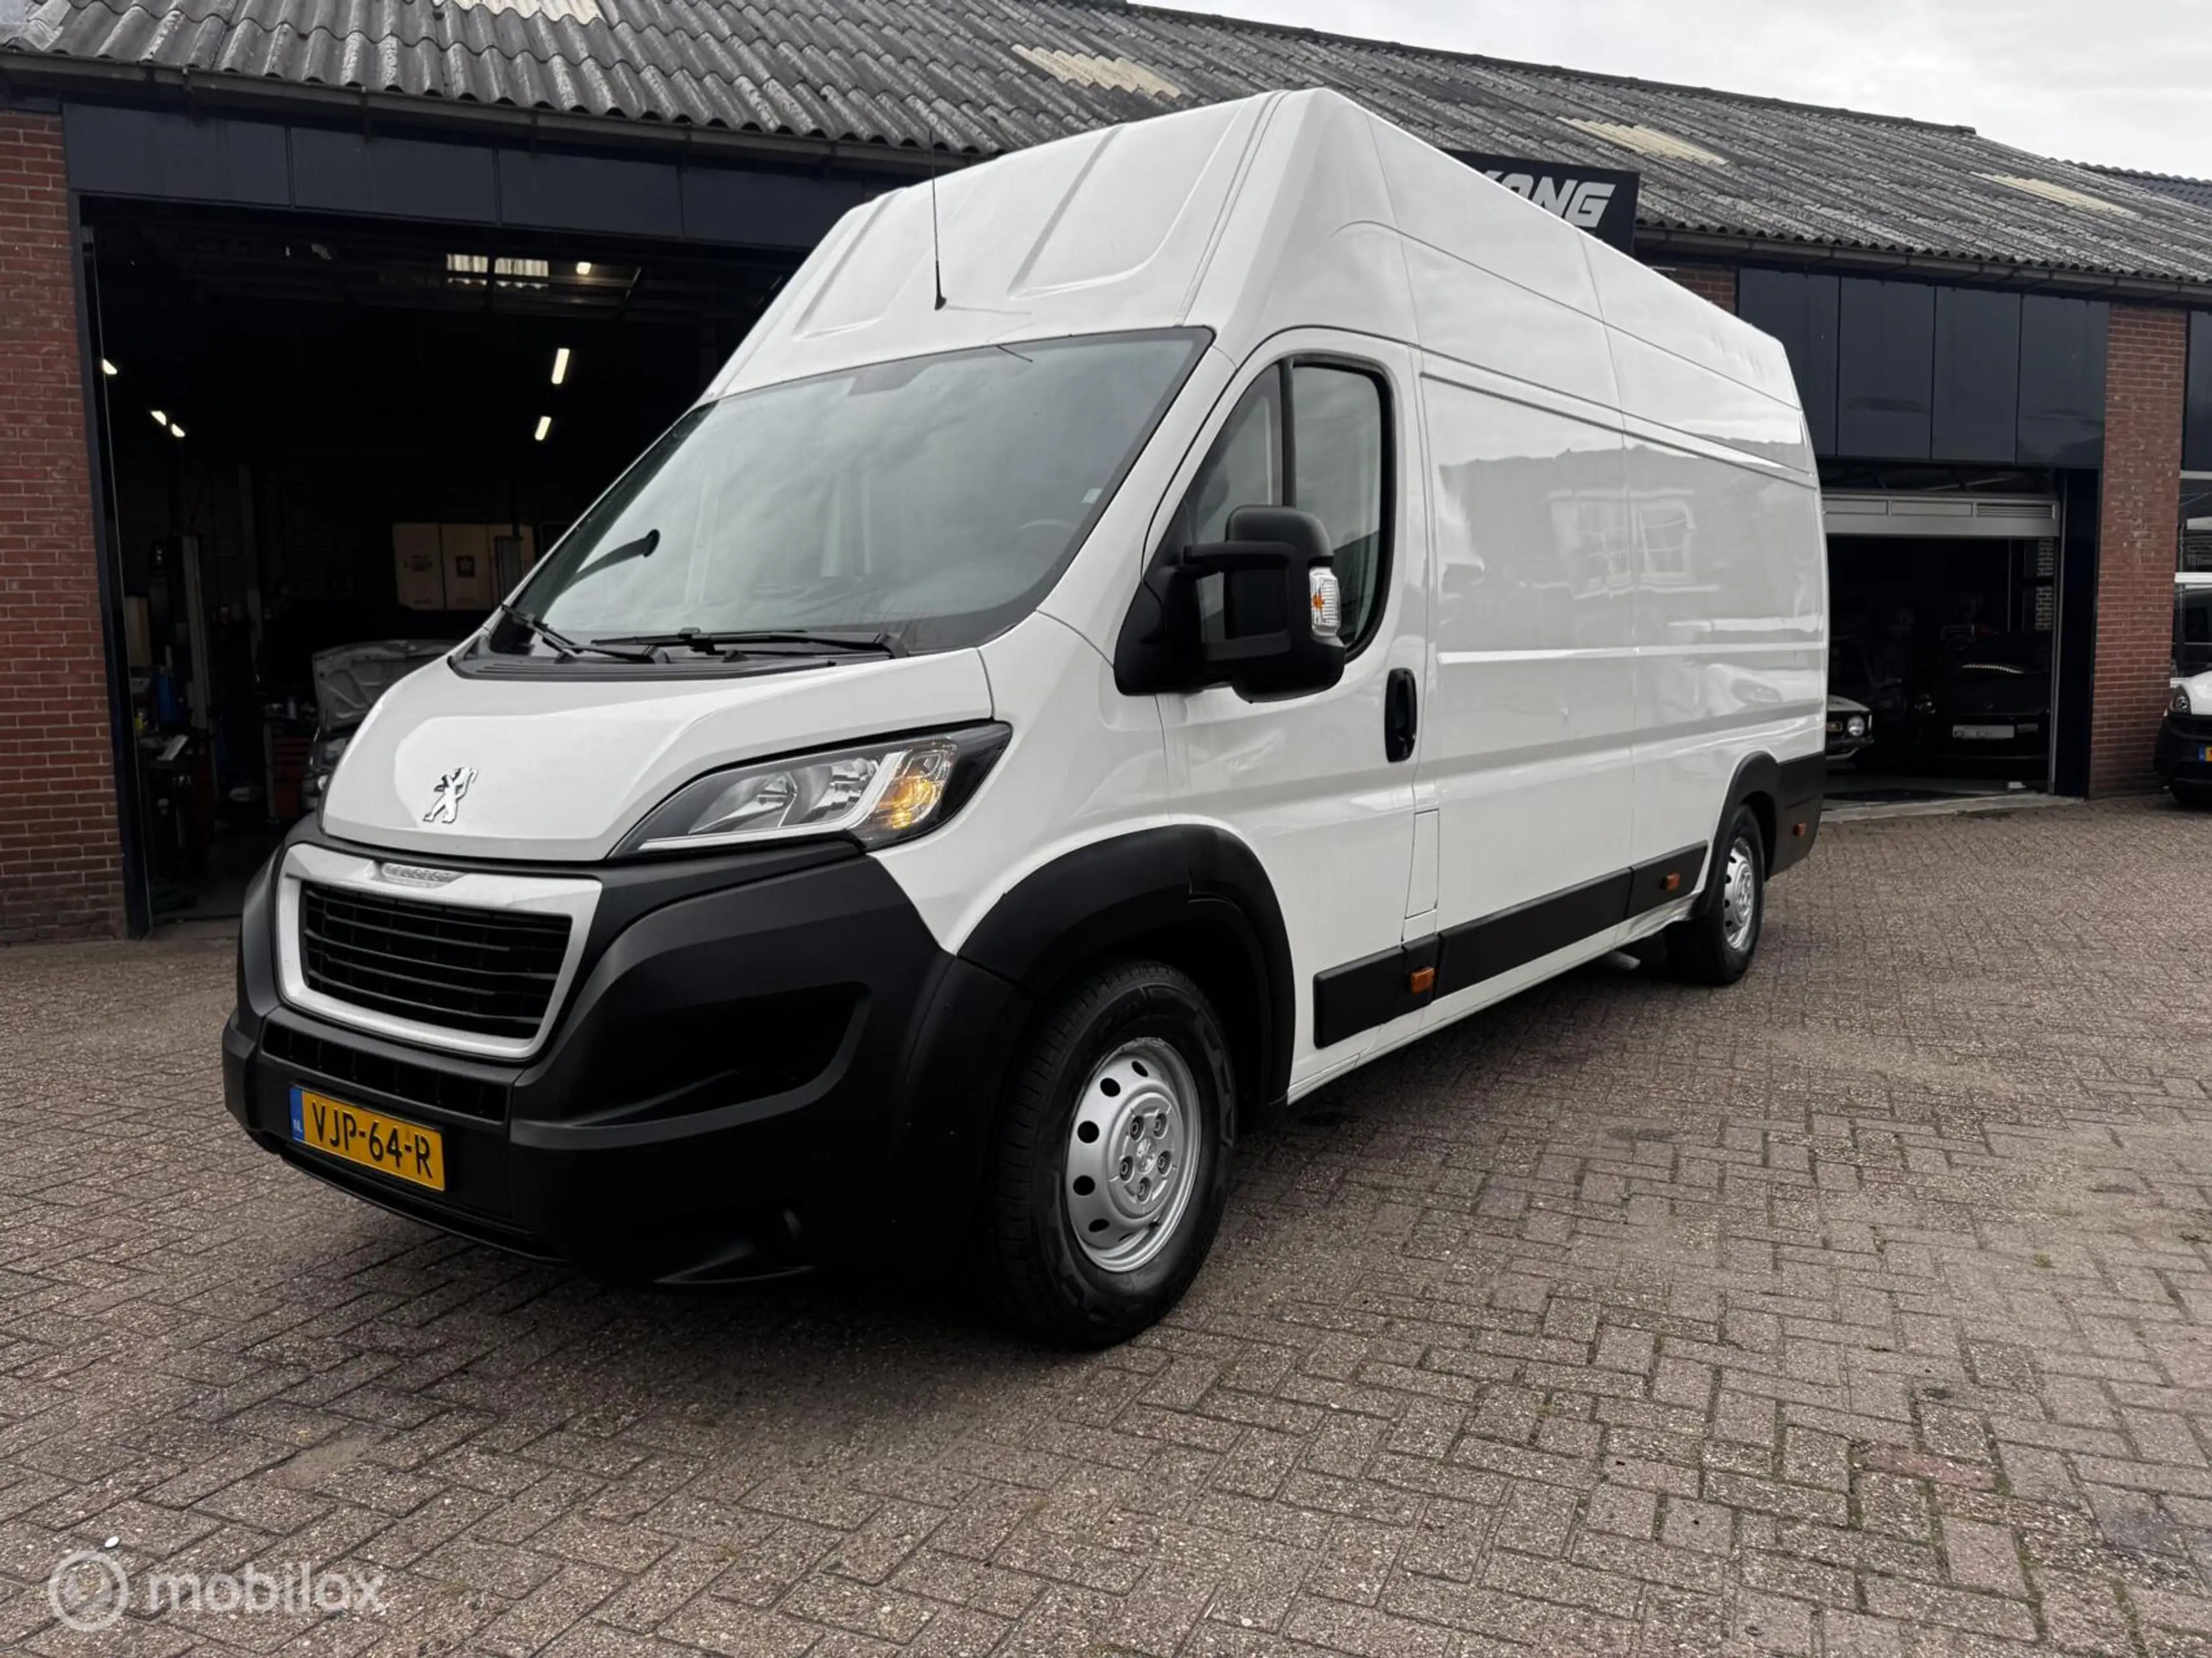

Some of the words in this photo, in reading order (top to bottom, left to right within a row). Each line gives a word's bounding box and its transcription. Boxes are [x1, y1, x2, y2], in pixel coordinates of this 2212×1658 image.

[1484, 170, 1616, 228] ONG
[293, 1119, 304, 1132] NL
[312, 1101, 433, 1179] VJP-64-R
